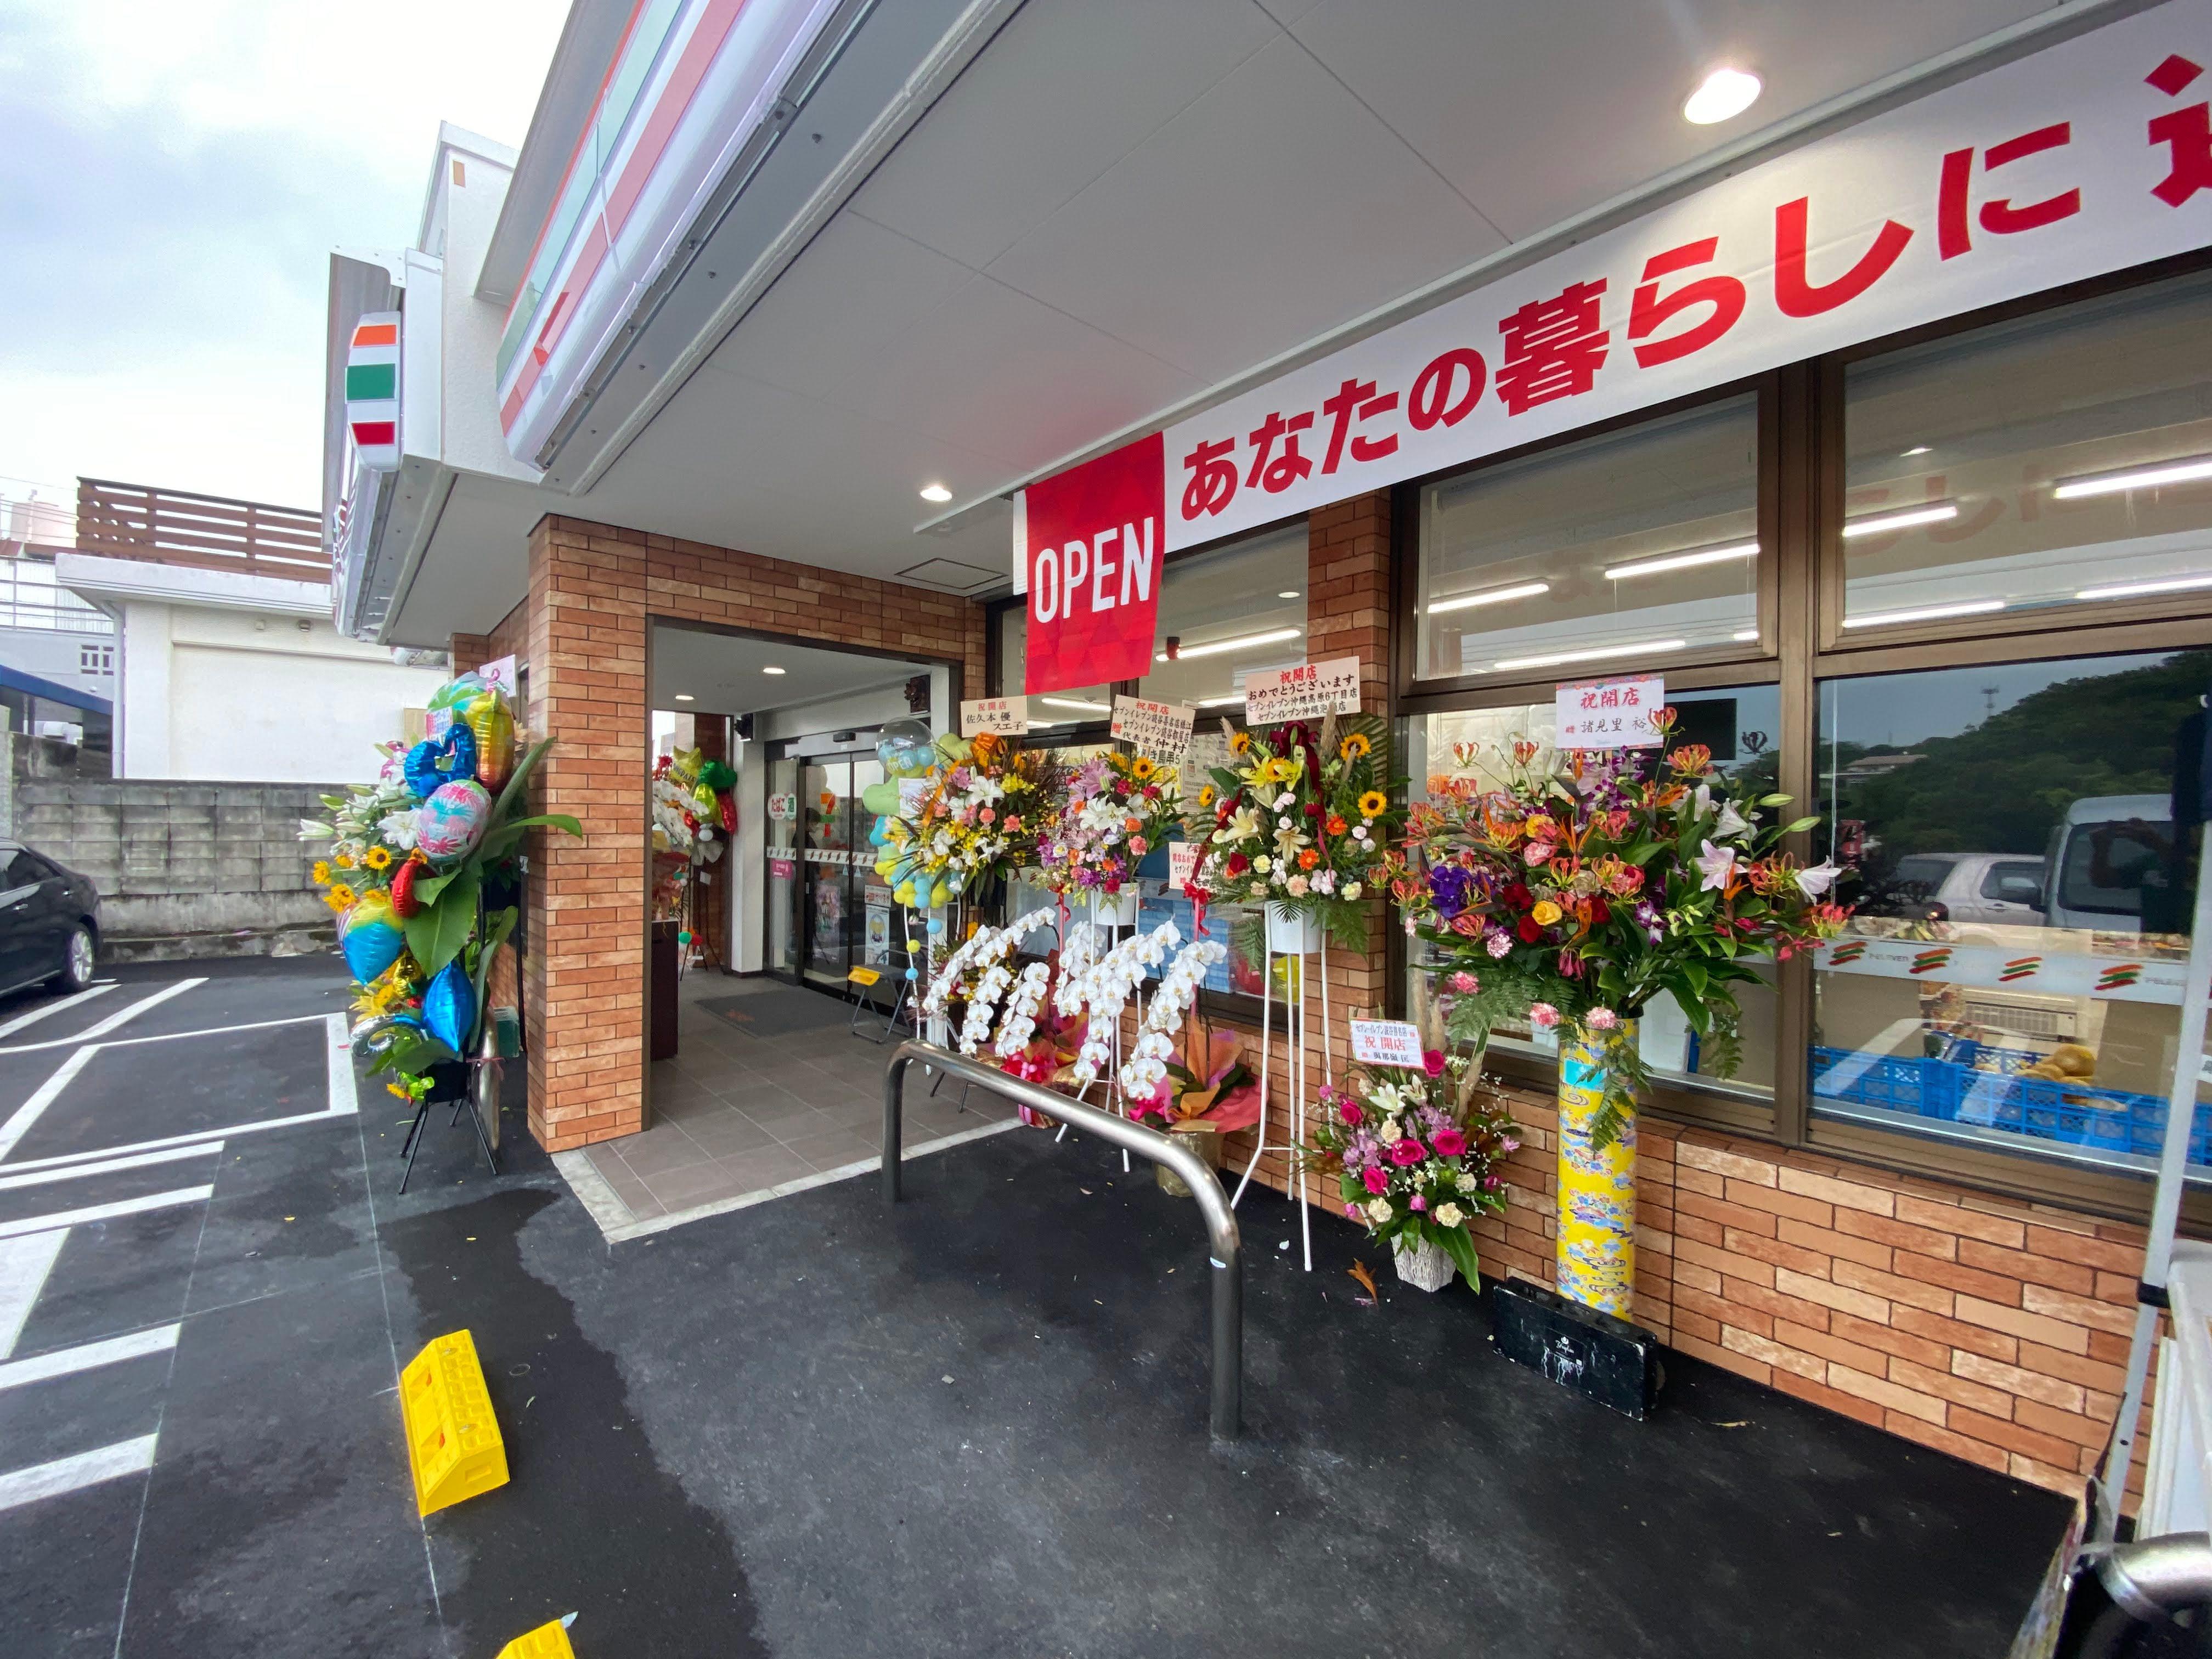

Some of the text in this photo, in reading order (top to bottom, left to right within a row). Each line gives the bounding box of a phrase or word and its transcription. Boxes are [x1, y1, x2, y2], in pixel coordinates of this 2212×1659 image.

[1035, 516, 1154, 623] OPEN
[1279, 664, 1317, 685] 祝開店
[1248, 674, 1355, 701] おめでとうございます
[978, 701, 1007, 712] 祝開店
[1580, 687, 1640, 710] 祝開店
[1136, 701, 1170, 715] 祝開店
[1257, 701, 1346, 721] セブンイレブン沖縄泡店
[966, 713, 996, 724] 佐久本
[1580, 718, 1622, 733] 諸見里
[1364, 1035, 1406, 1051] 祝開店
